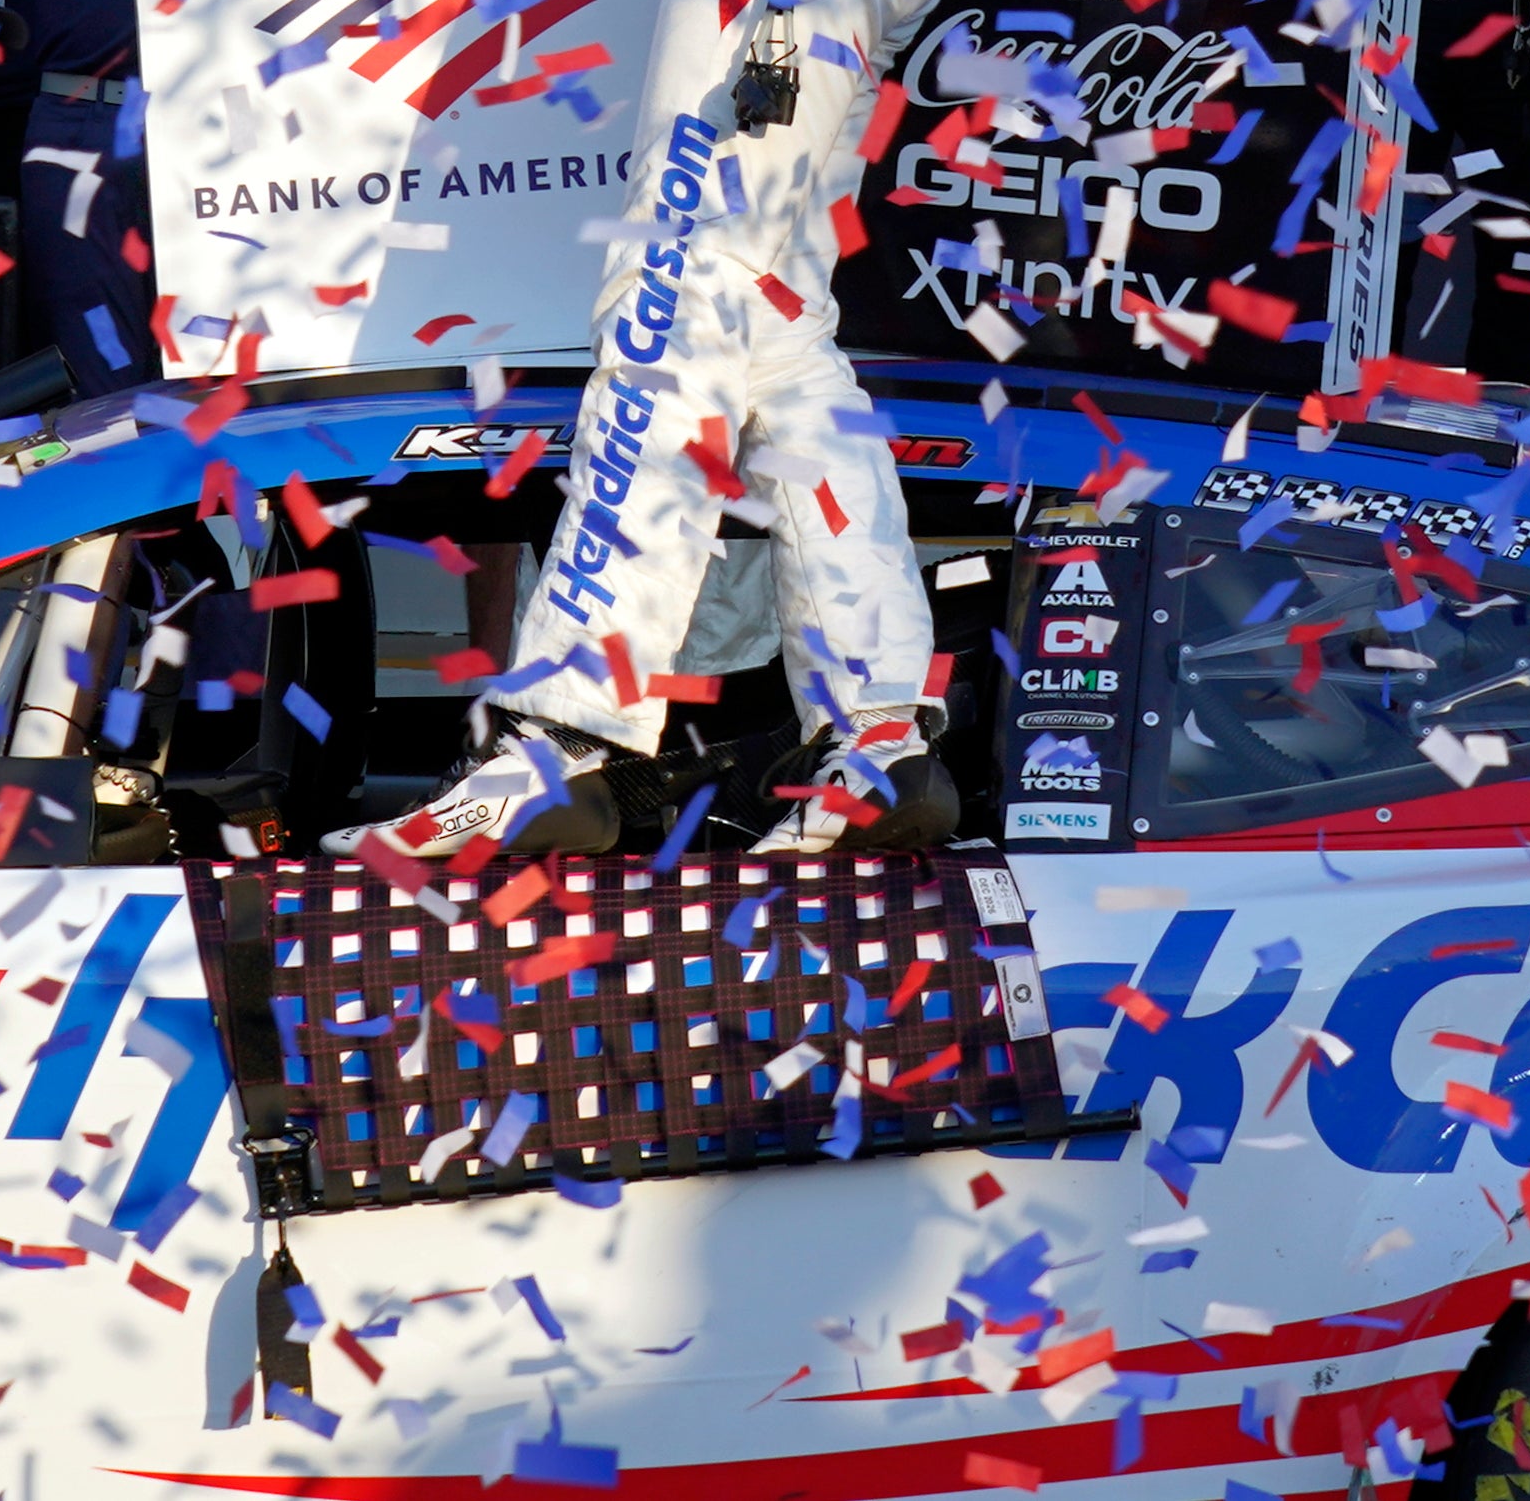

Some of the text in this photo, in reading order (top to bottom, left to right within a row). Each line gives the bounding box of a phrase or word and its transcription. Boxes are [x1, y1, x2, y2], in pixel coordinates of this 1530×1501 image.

[194, 150, 633, 219] BANK OF AMERIC
[895, 143, 1223, 235] GEICO
[615, 112, 719, 365] Cars.com
[1041, 593, 1116, 608] AXALTA
[1020, 669, 1120, 692] CLIMB
[1026, 714, 1106, 726] FREIGHTLINER
[1020, 777, 1102, 792] TOOLS
[427, 801, 490, 843] parco
[1017, 813, 1098, 828] SIEMENS
